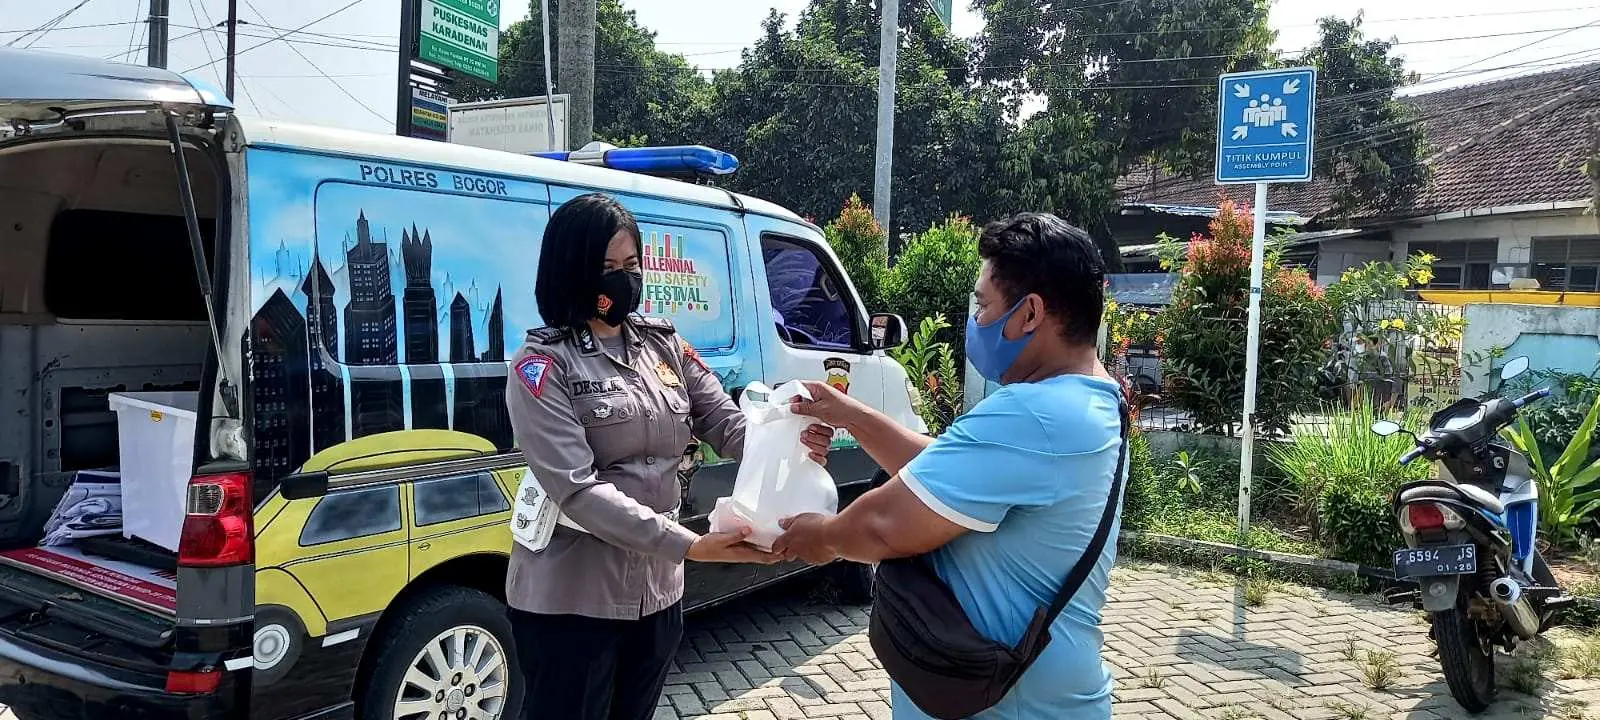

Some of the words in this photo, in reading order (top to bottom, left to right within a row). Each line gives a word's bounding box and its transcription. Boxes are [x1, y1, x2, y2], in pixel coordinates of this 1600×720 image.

[433, 7, 488, 38] PUSKESMAS
[432, 21, 488, 53] KARADENAN
[1225, 154, 1252, 163] TITIK
[1255, 151, 1302, 161] KUMPUL
[1234, 162, 1269, 170] ASSEMBLY
[360, 164, 438, 189] POLRES
[453, 175, 508, 196] BOGOR
[643, 256, 696, 274] ILLENNIAL
[645, 271, 661, 284] AD
[664, 272, 708, 287] SAFETY
[646, 284, 709, 303] FESTIVAL
[1395, 553, 1402, 566] F
[1409, 549, 1439, 563] 6594
[1457, 546, 1473, 561] JS
